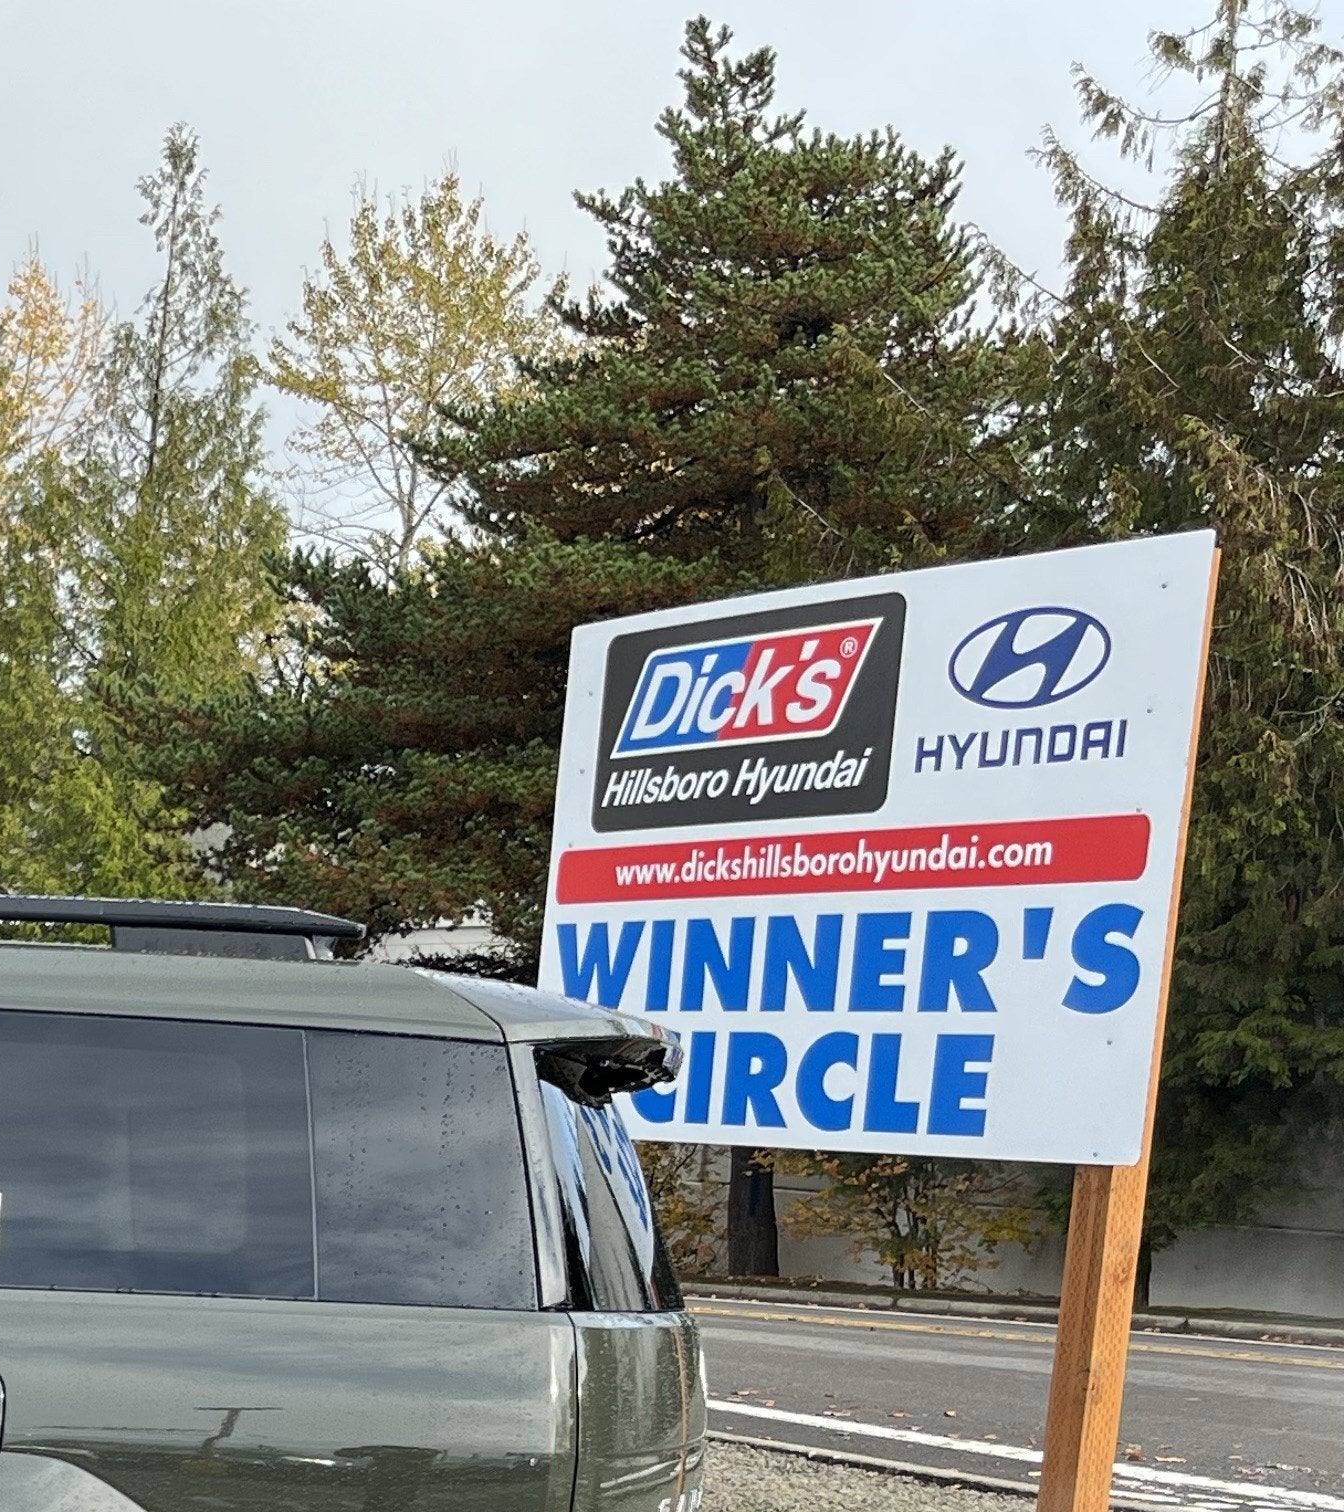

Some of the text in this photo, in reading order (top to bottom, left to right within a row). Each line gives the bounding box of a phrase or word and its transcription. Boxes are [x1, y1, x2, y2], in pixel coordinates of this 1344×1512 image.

[914, 718, 1128, 773] HYUNDAI
[601, 747, 873, 807] Hillsboro Hyundai
[615, 834, 1053, 886] www.dickshillsborohyundai.com
[555, 903, 1145, 1015] WINNER'S
